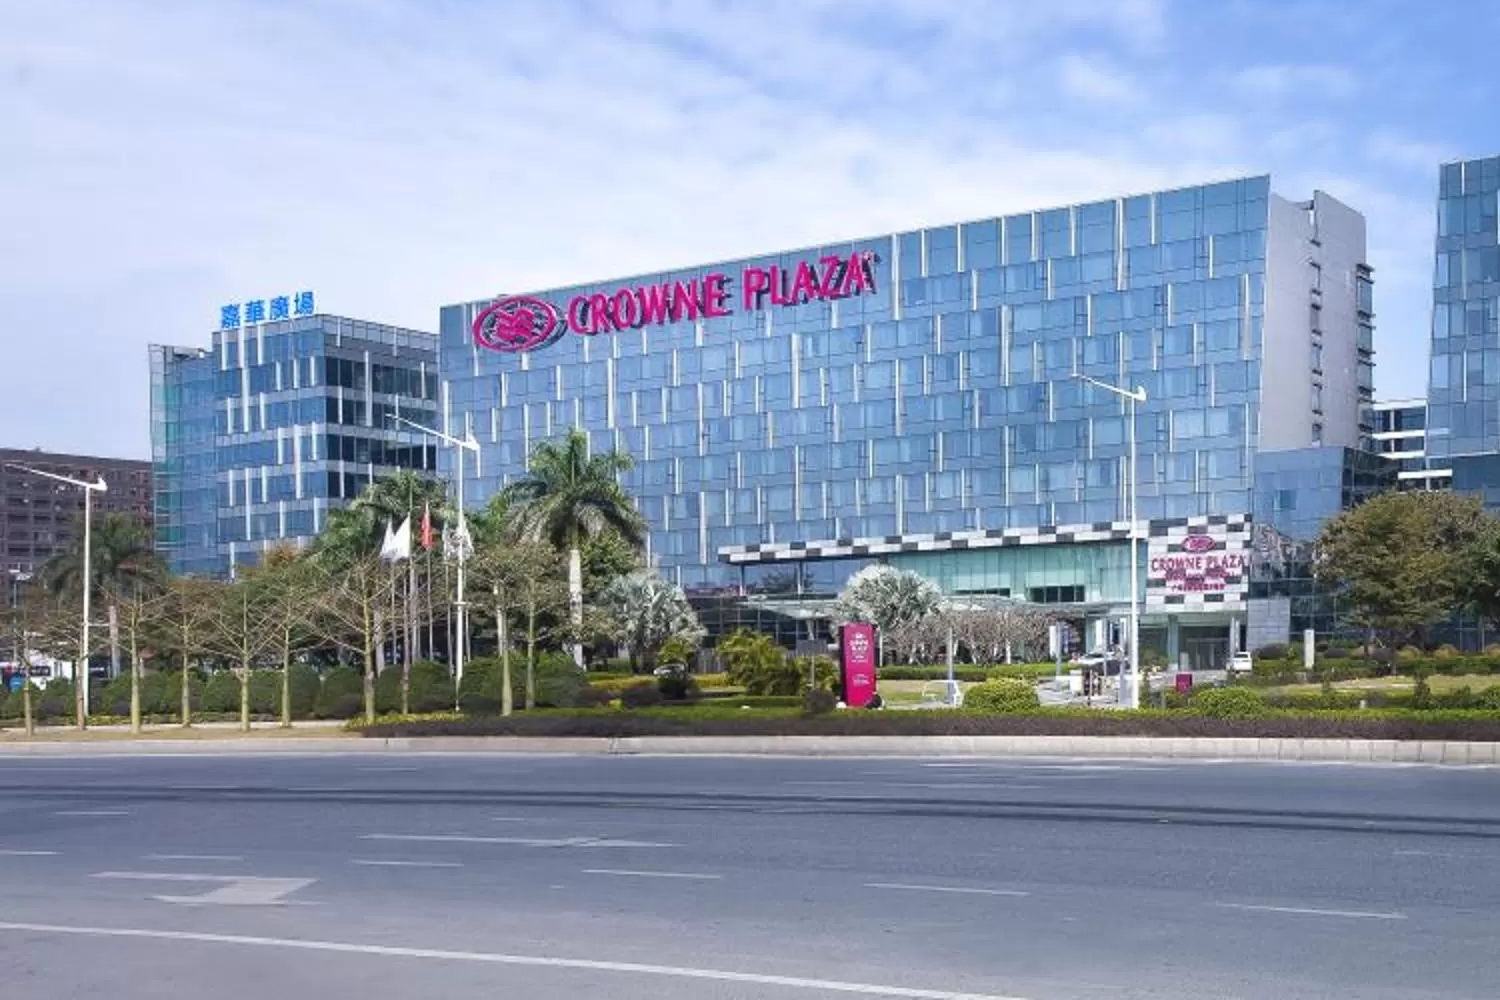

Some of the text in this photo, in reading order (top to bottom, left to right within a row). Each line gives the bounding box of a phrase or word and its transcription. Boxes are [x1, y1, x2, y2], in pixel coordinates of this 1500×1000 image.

[567, 252, 869, 335] CROWNE PLAZA
[1151, 554, 1246, 572] CROWNE PLAZA
